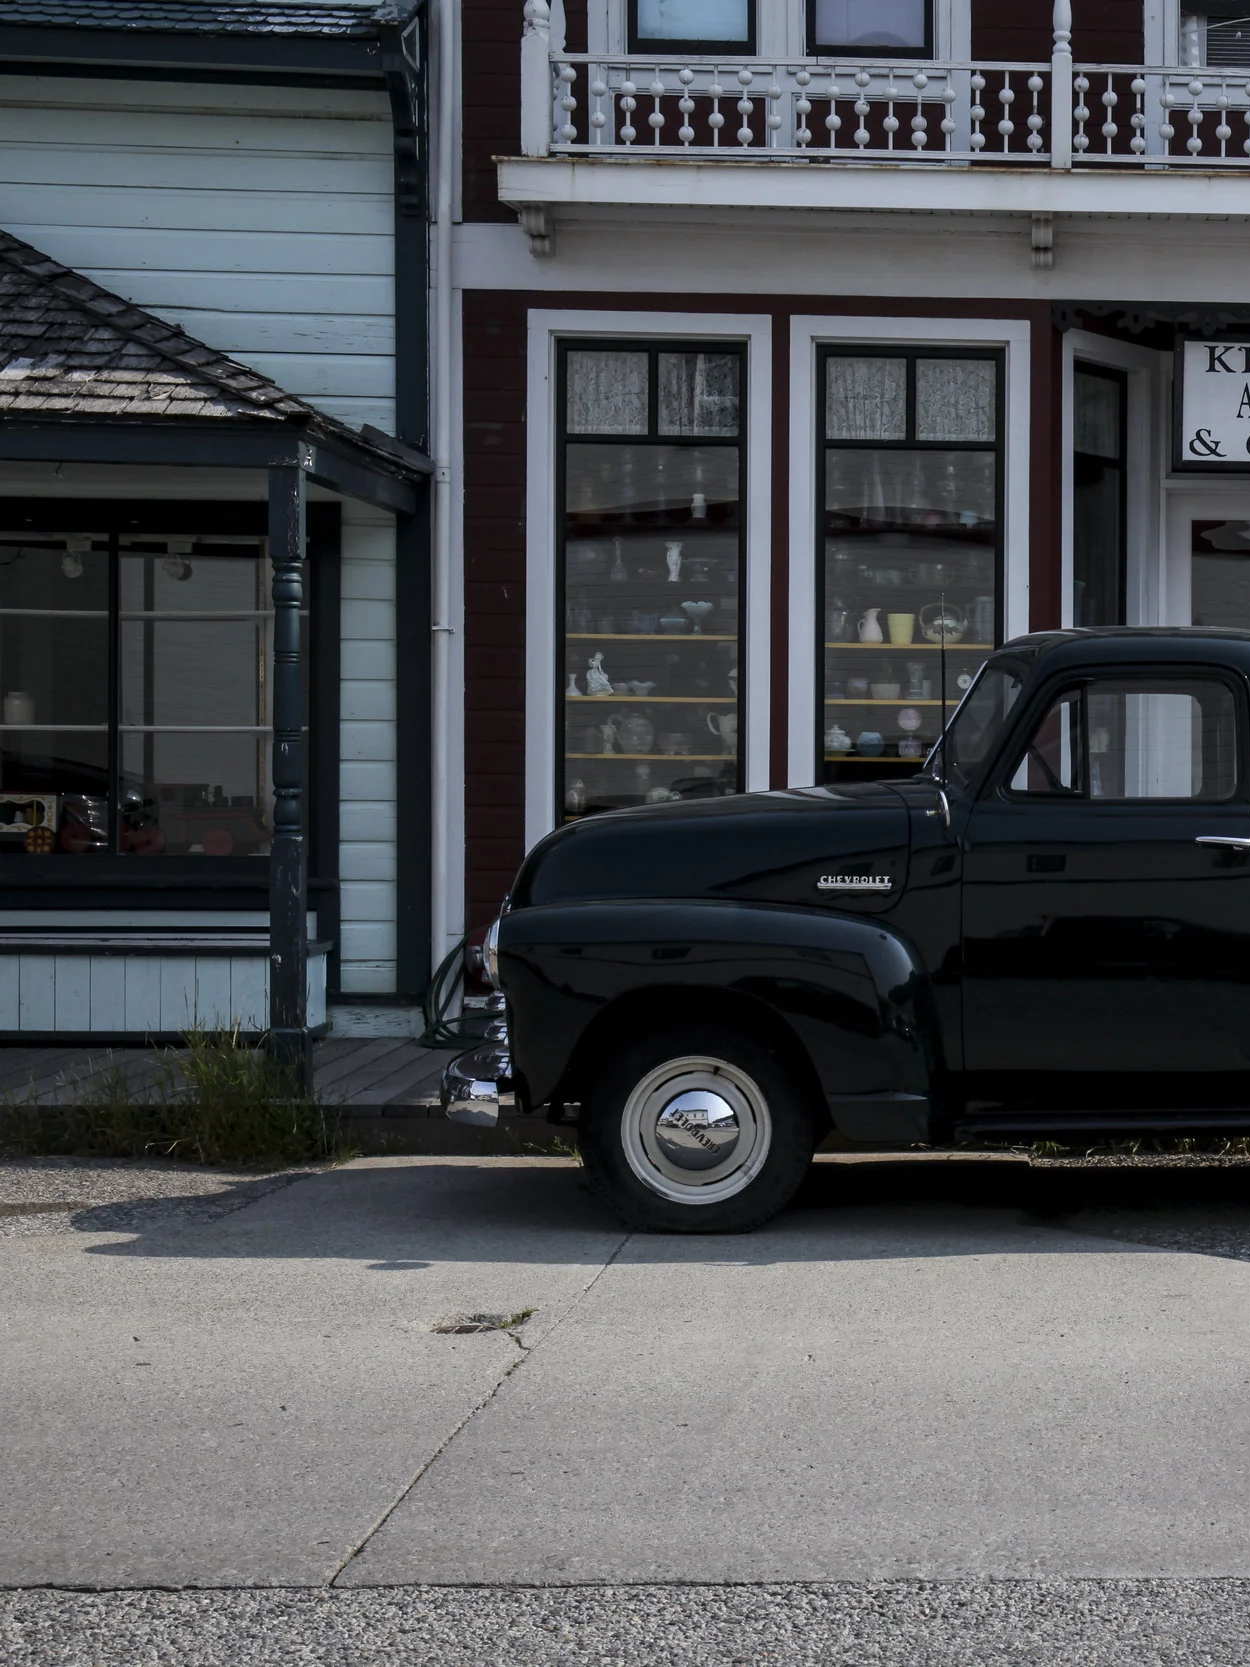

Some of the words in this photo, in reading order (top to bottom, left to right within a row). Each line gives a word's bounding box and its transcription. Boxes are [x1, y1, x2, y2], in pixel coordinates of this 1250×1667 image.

[1189, 428, 1227, 457] &
[820, 875, 890, 885] CHEVROLET
[669, 1108, 721, 1154] CHEVROLET
